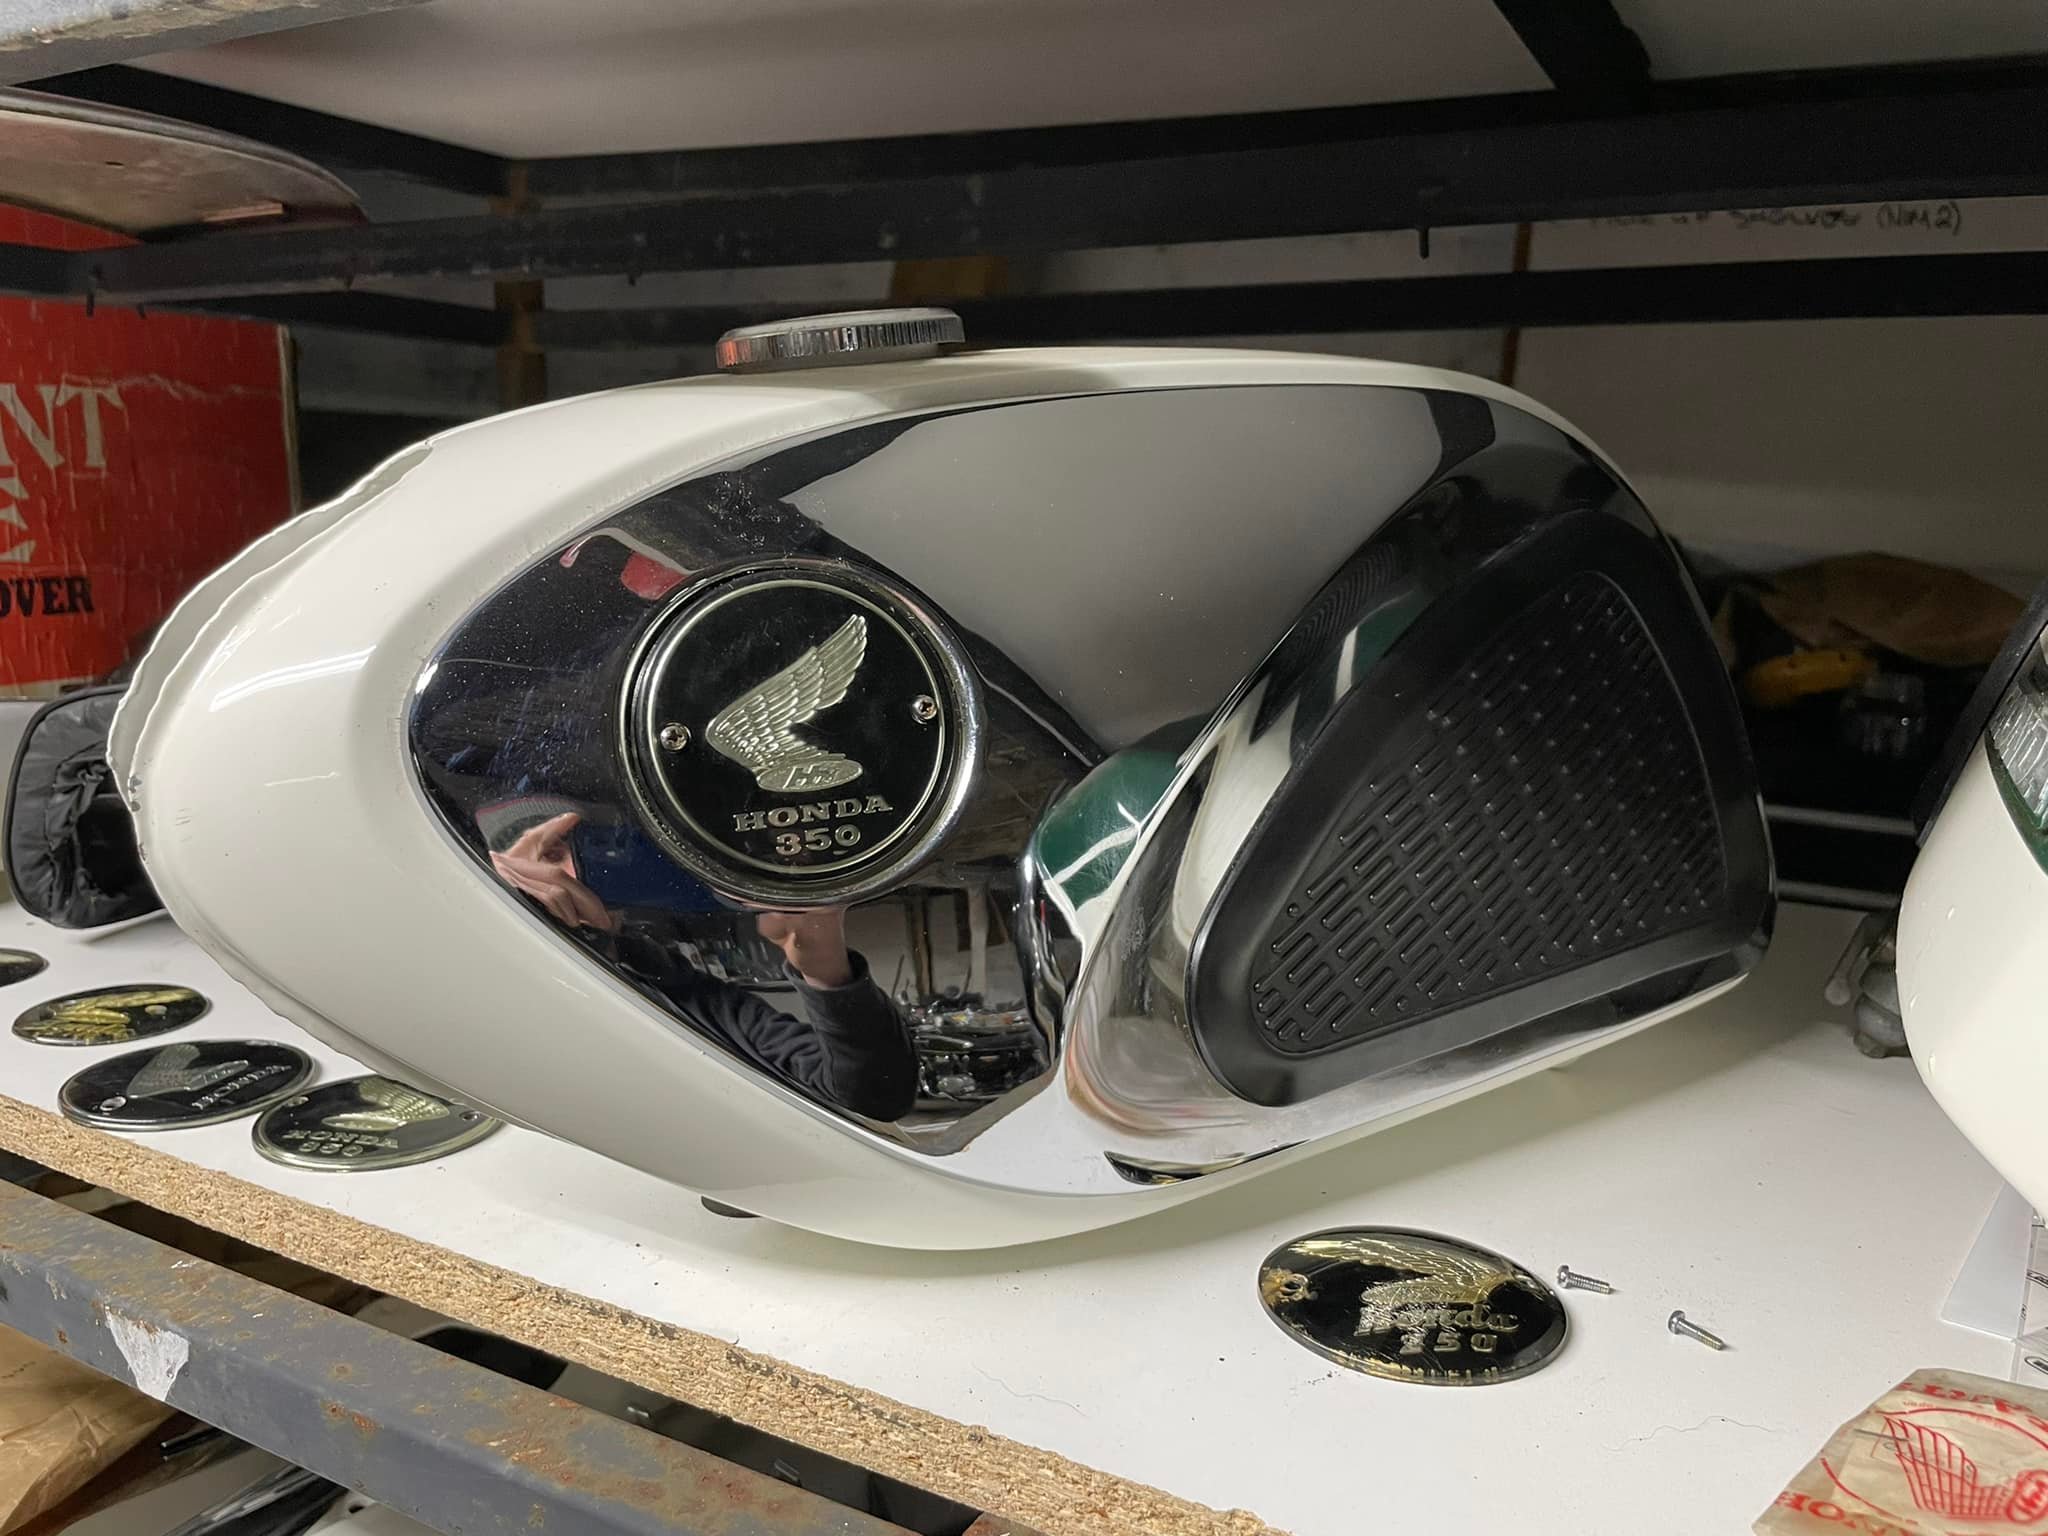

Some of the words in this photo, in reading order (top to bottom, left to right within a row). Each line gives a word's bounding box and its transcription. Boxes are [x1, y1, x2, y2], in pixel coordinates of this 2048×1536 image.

[732, 795, 893, 832] HONDA
[775, 824, 861, 856] 350
[281, 1129, 399, 1149] HONDA
